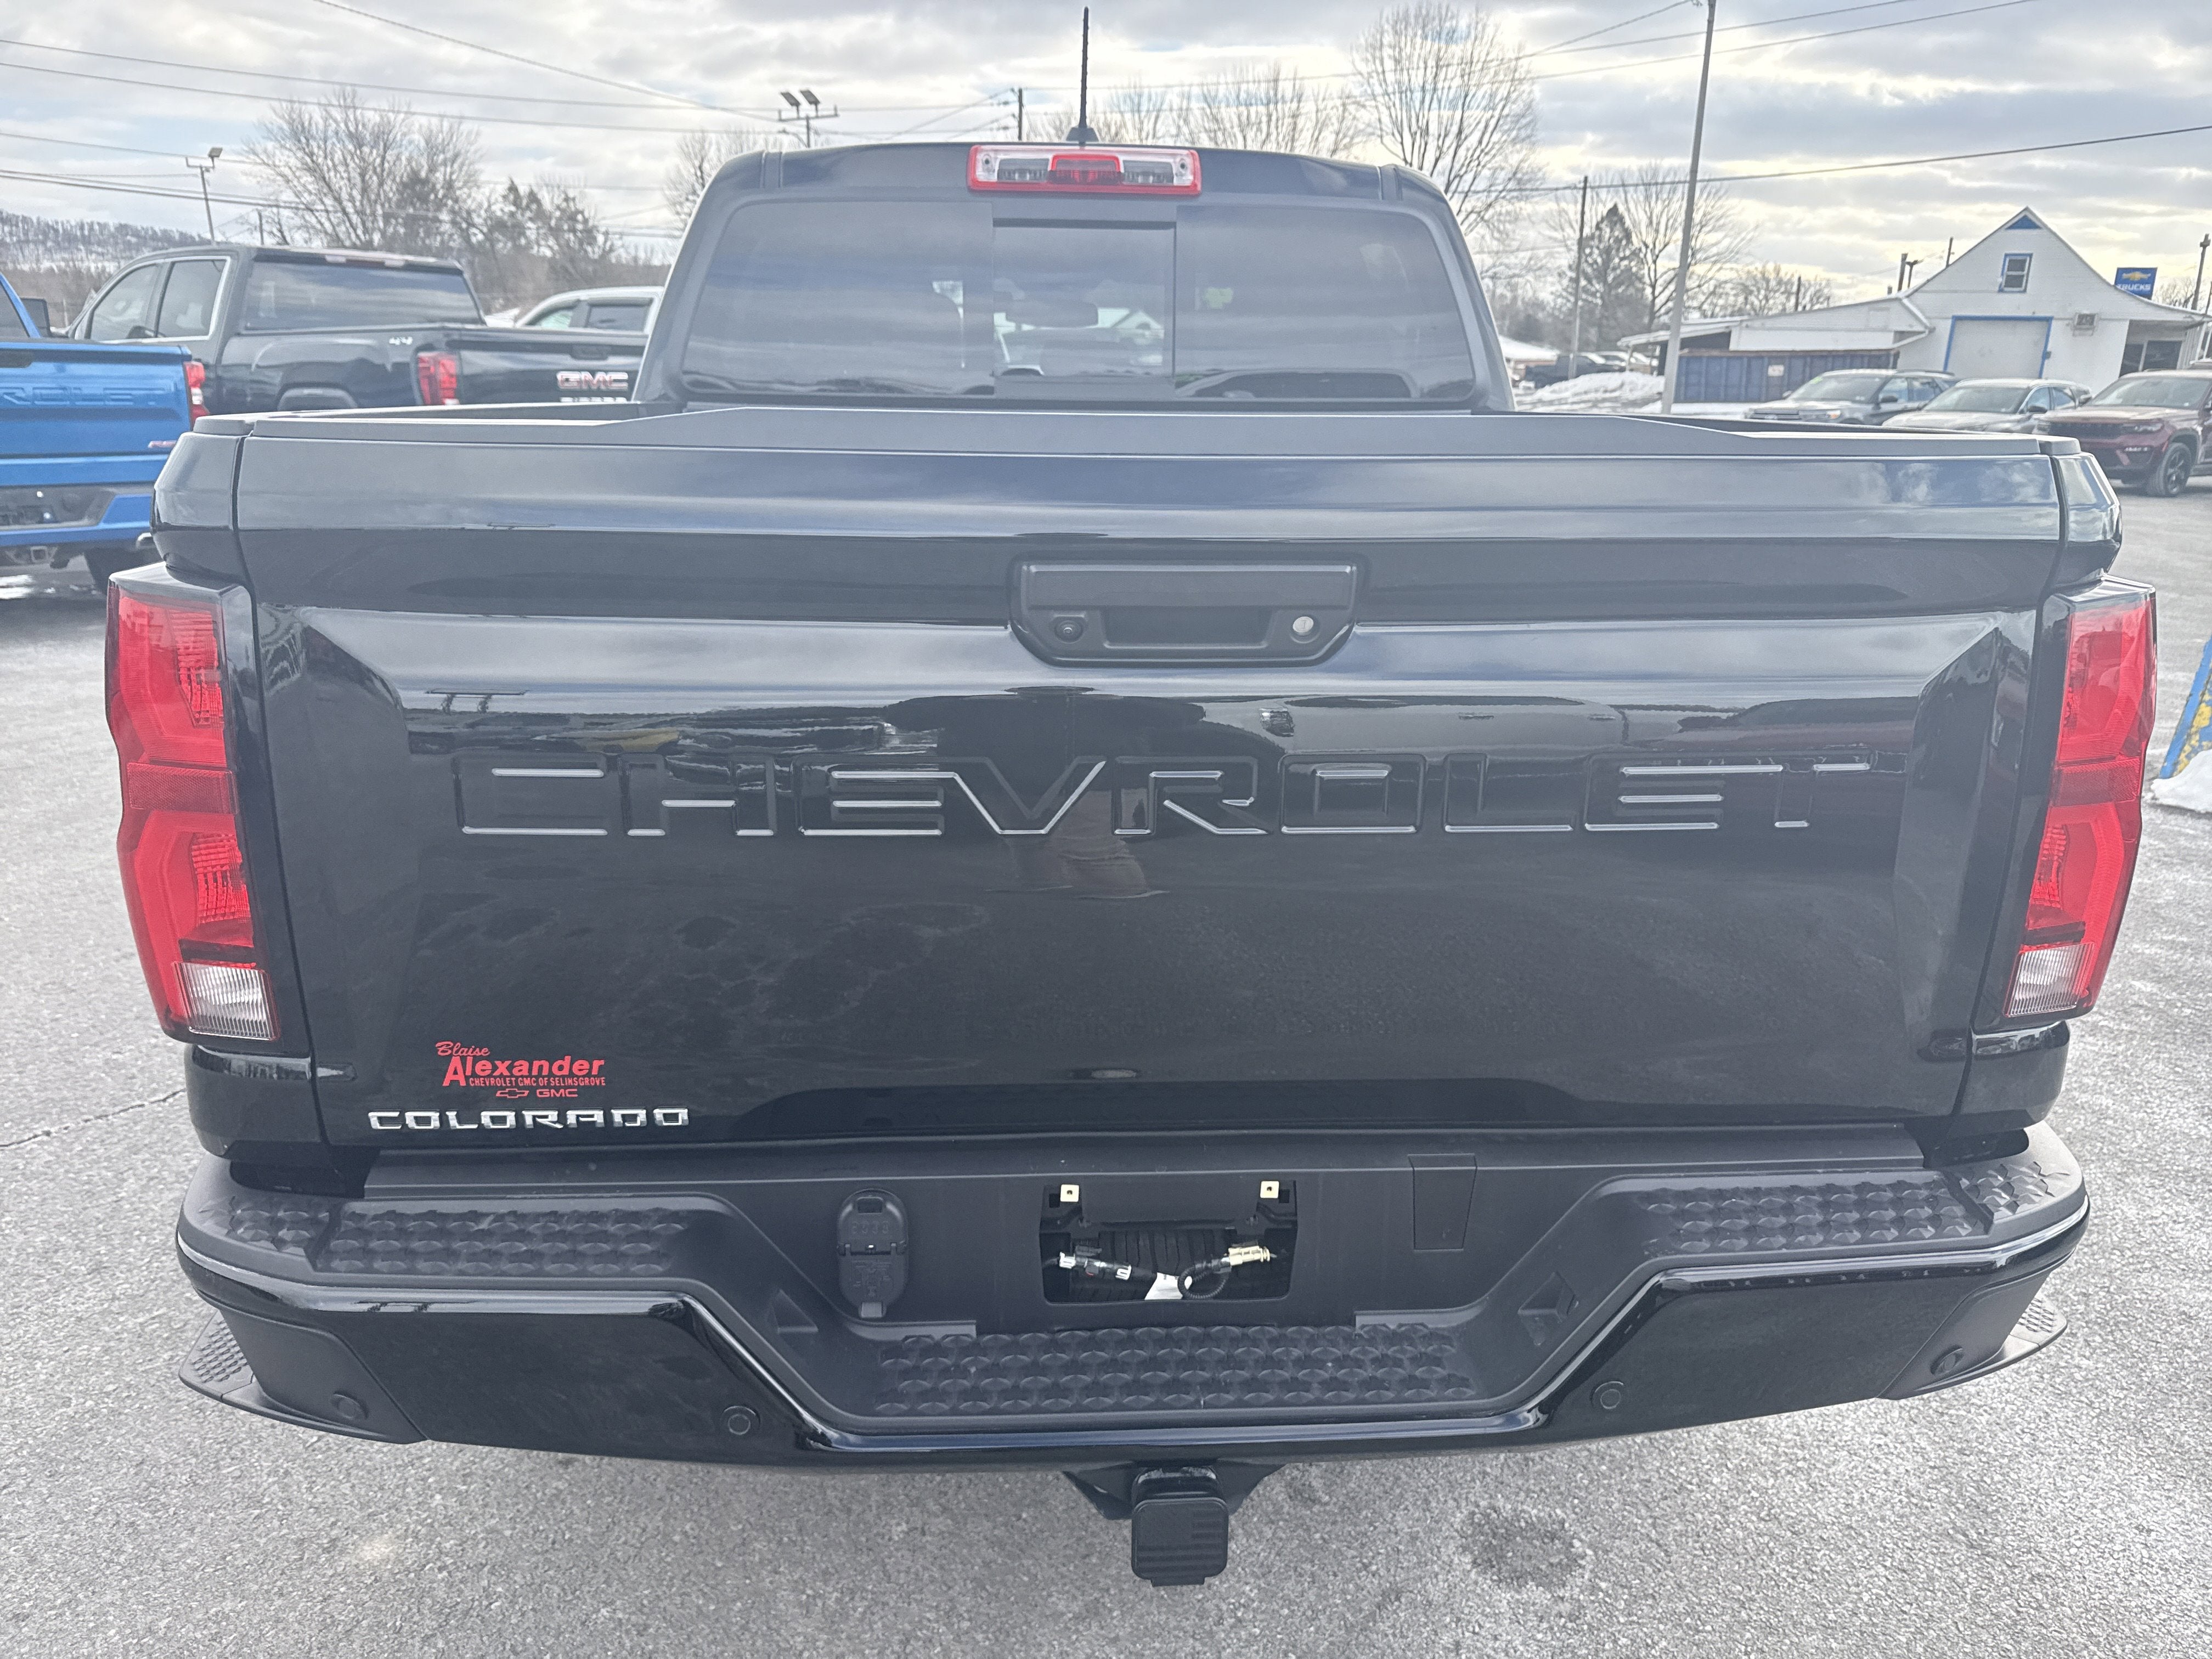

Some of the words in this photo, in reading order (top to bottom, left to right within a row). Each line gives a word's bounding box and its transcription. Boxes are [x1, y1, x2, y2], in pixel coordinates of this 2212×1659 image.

[556, 370, 629, 391] GMC
[451, 752, 1873, 836] CHEVROLET
[435, 1041, 490, 1057] Blaise
[443, 1055, 606, 1087] Alexander
[469, 1077, 516, 1087] CHEVROLET
[517, 1077, 537, 1087] GMC
[538, 1077, 549, 1087] OF
[550, 1076, 606, 1087] SELINSGROVE
[536, 1088, 578, 1098] GMC
[367, 1107, 690, 1130] COLORADO
